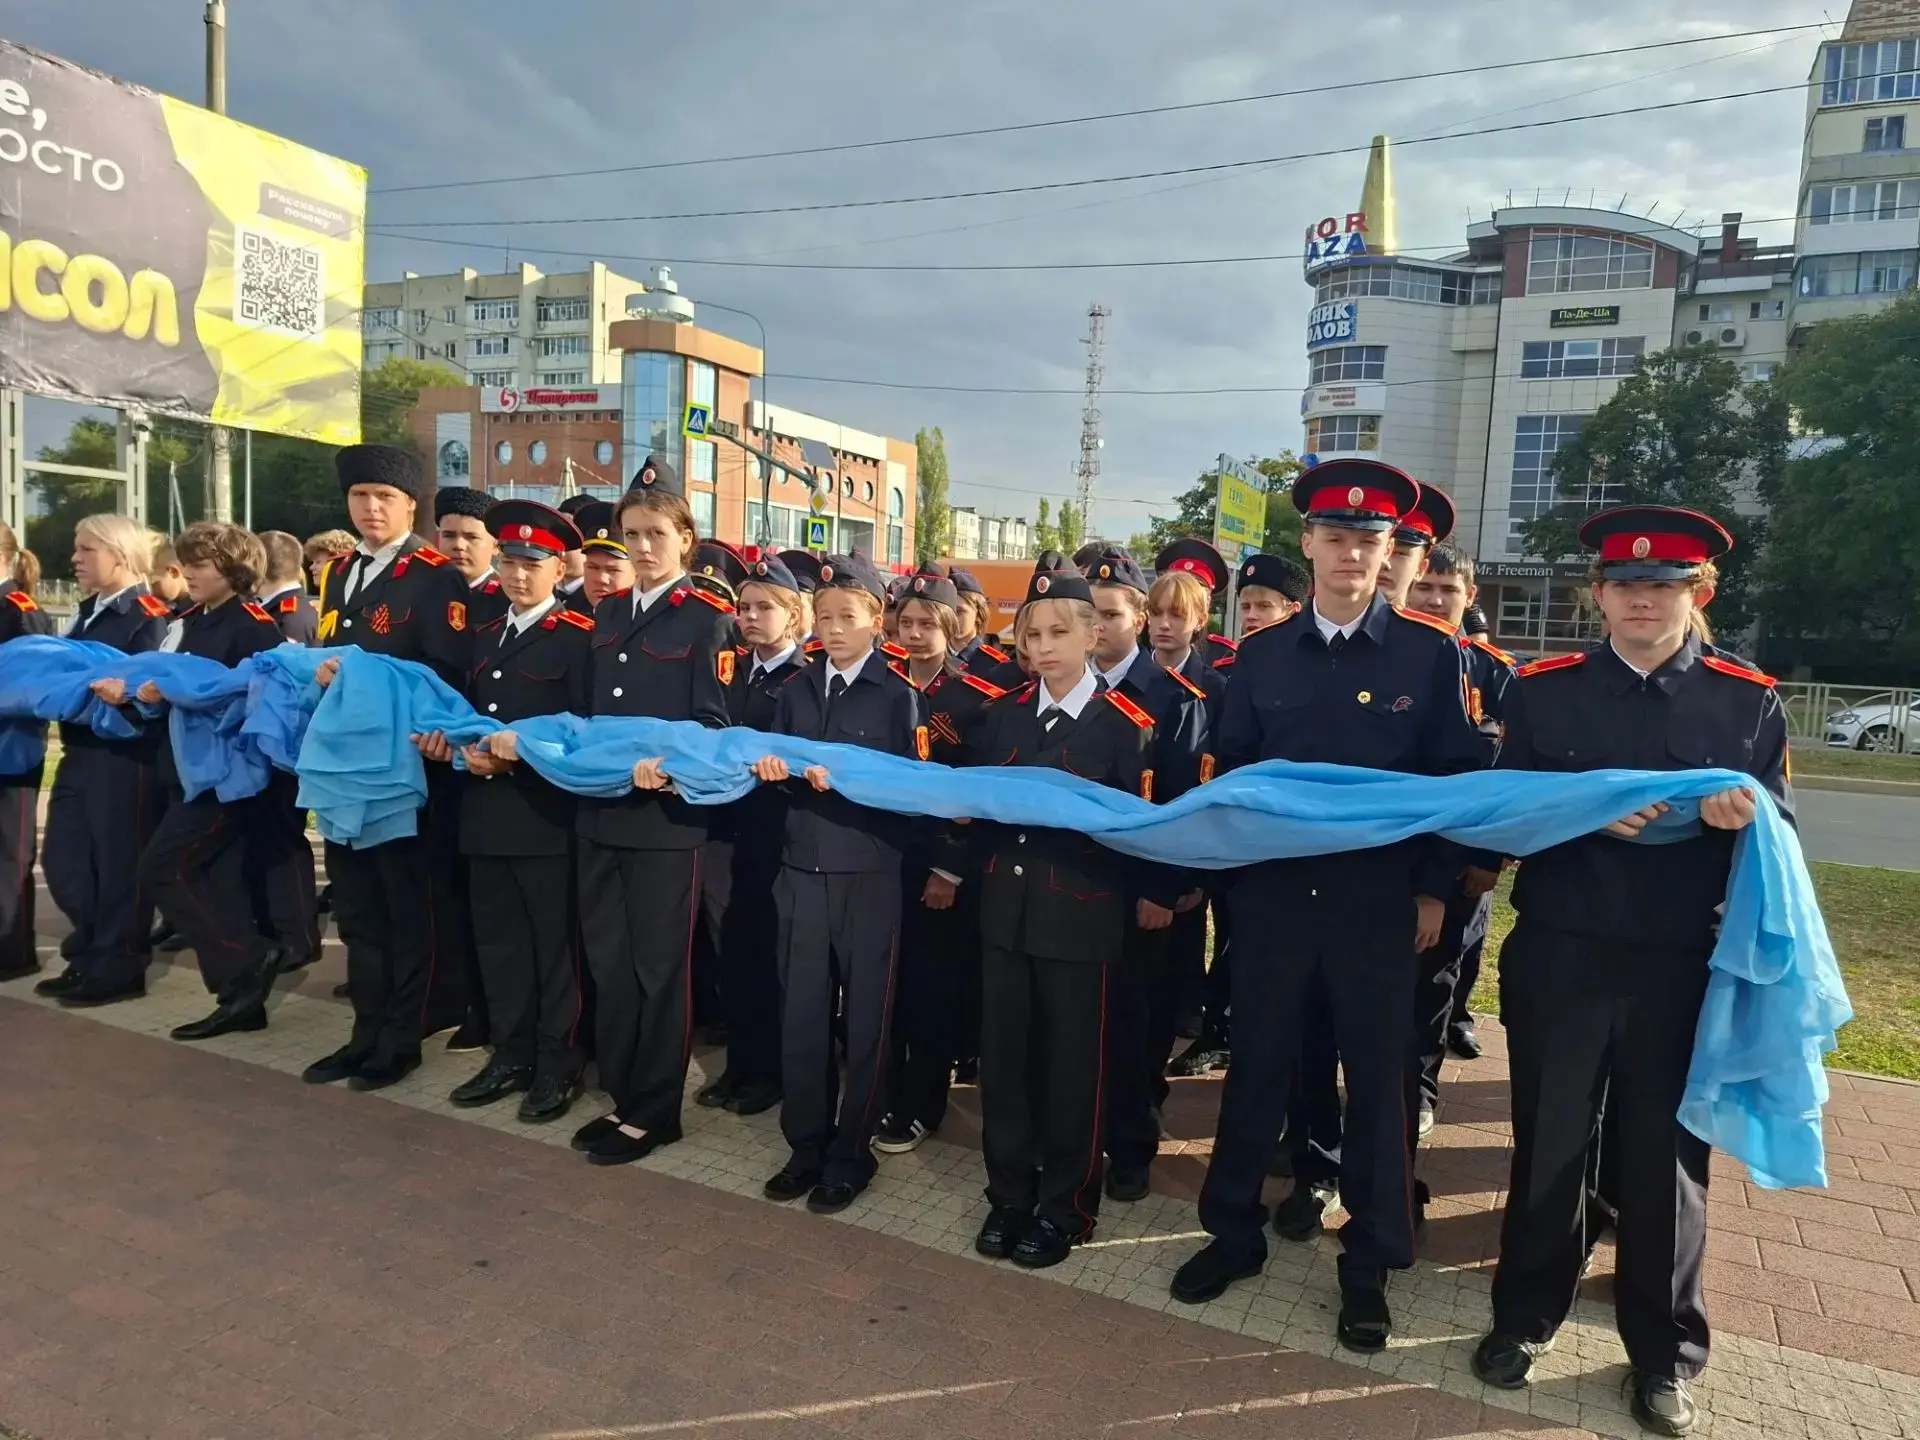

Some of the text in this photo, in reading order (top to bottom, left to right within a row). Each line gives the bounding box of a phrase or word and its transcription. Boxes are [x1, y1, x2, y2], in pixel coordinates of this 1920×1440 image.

[1306, 212, 1369, 240] OR
[1559, 308, 1610, 319] Па-Де-Ша
[1473, 564, 1493, 576] Mr.
[1497, 564, 1554, 577] Freeman
